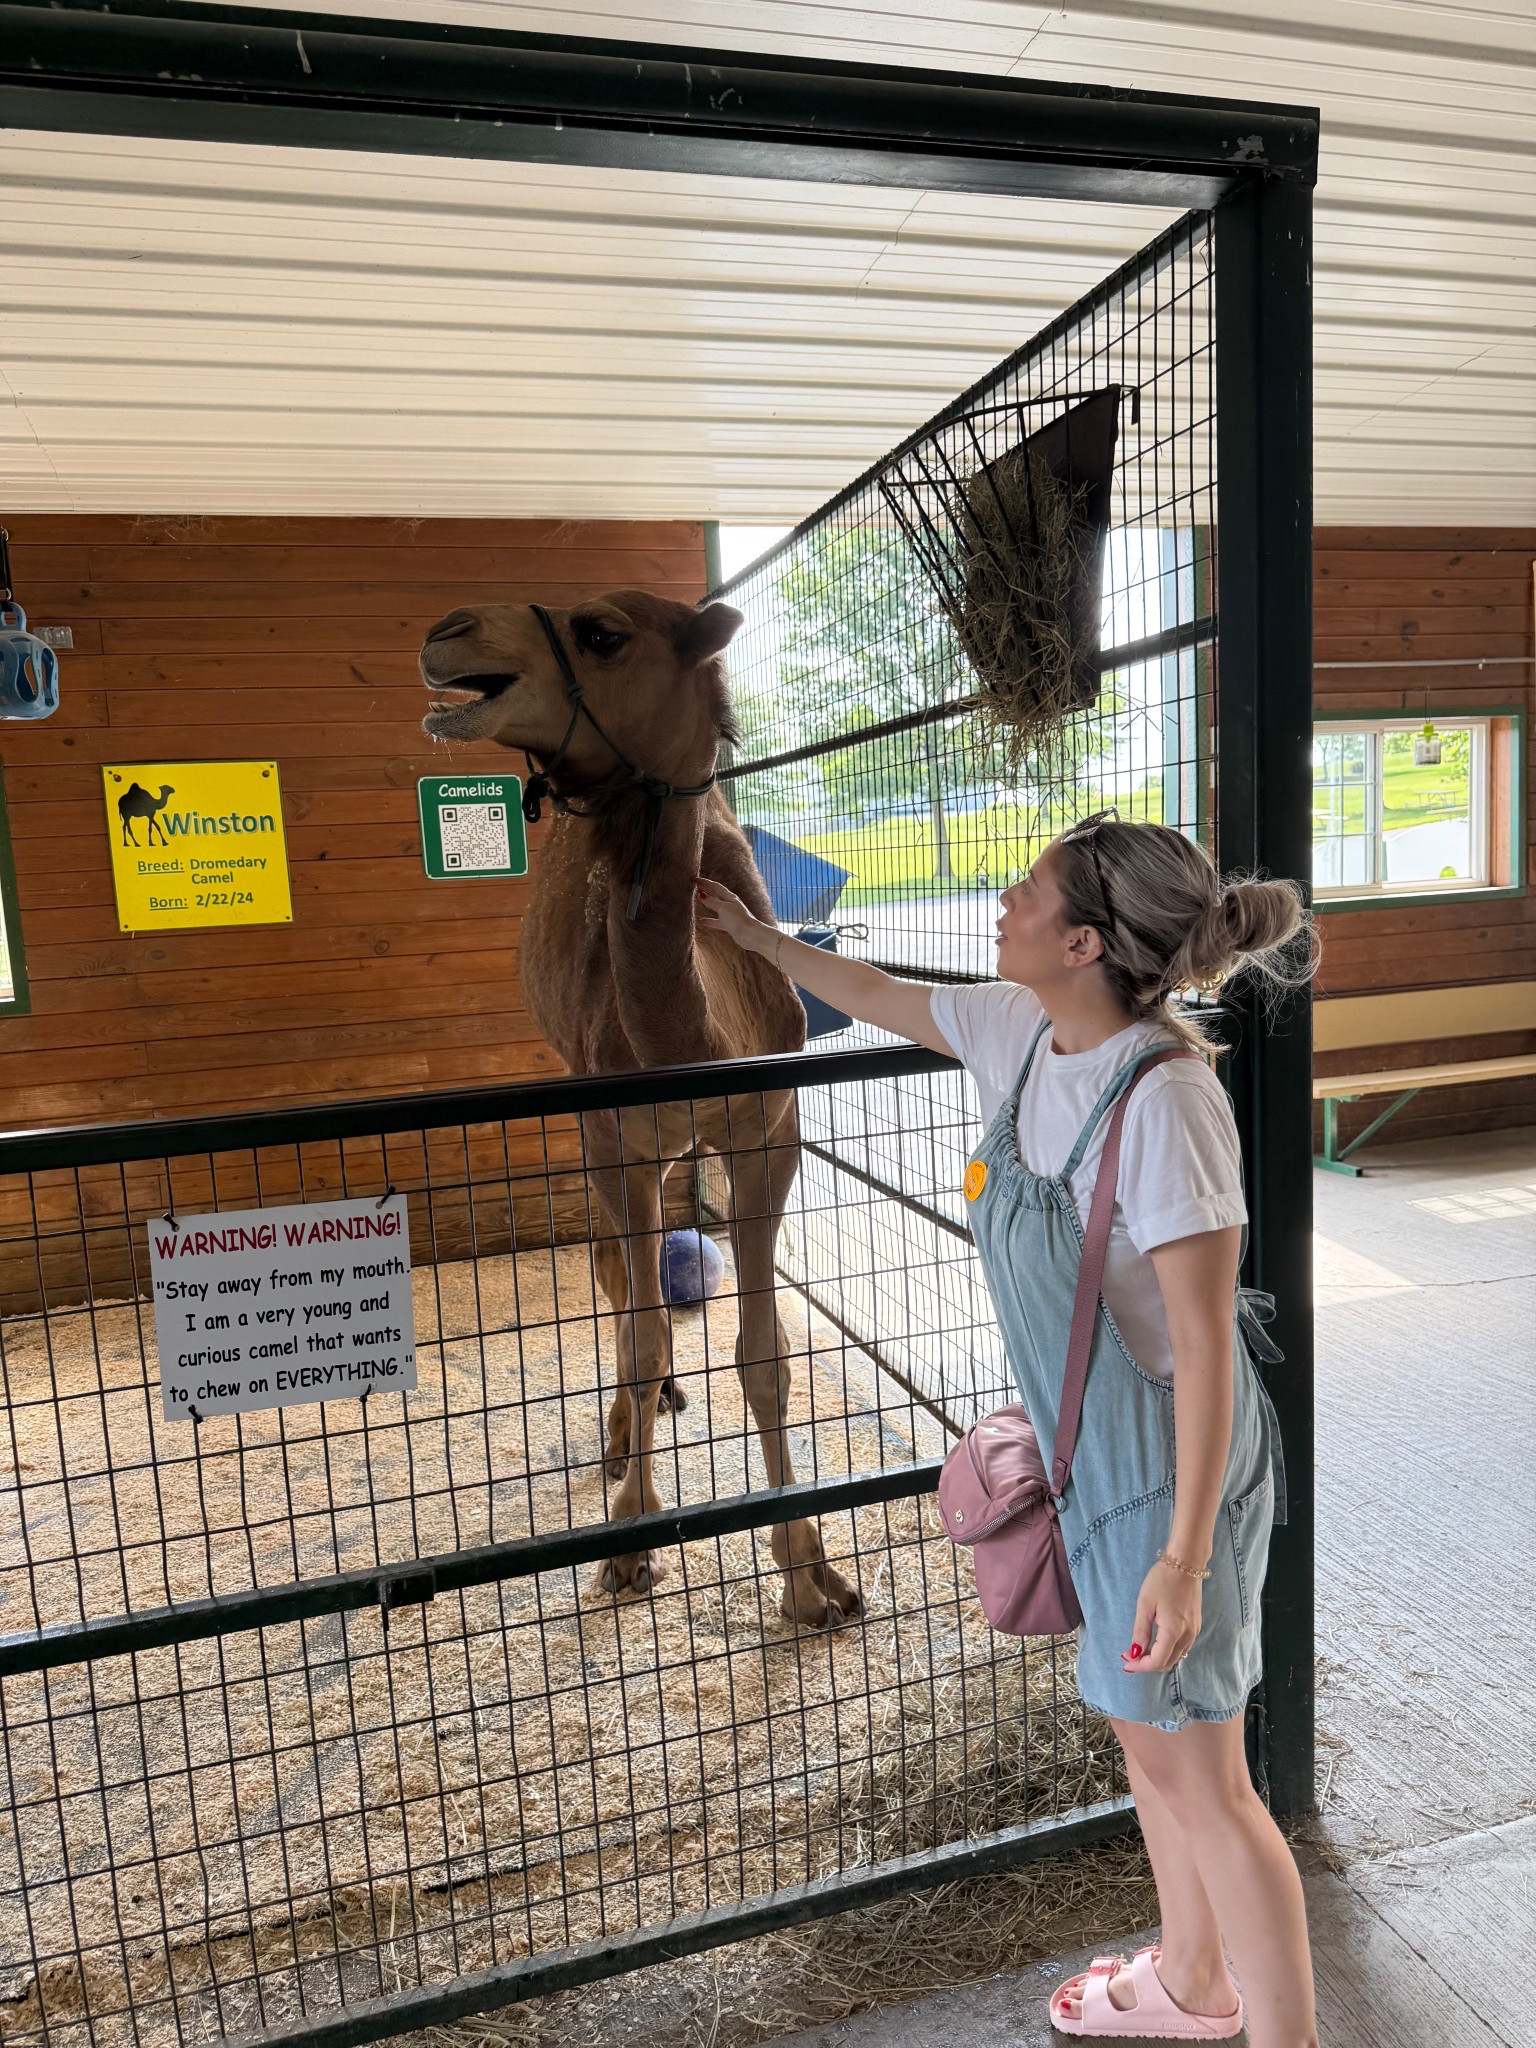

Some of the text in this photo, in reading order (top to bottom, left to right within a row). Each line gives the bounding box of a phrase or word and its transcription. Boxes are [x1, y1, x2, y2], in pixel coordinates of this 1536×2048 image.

[439, 782, 503, 797] Camelids
[163, 812, 275, 836] Winston
[138, 857, 267, 875] Breed: Dromedary
[192, 872, 233, 884] Camel
[150, 892, 253, 910] Born: 2/22/24
[155, 1212, 401, 1259] WARNING! WARNING!
[156, 1257, 410, 1301] "Stay away from my mouth.
[186, 1292, 389, 1332] I am a very young and
[178, 1327, 401, 1367] curious camel that wants
[169, 1355, 413, 1403] to chew on EVERYTHING."
